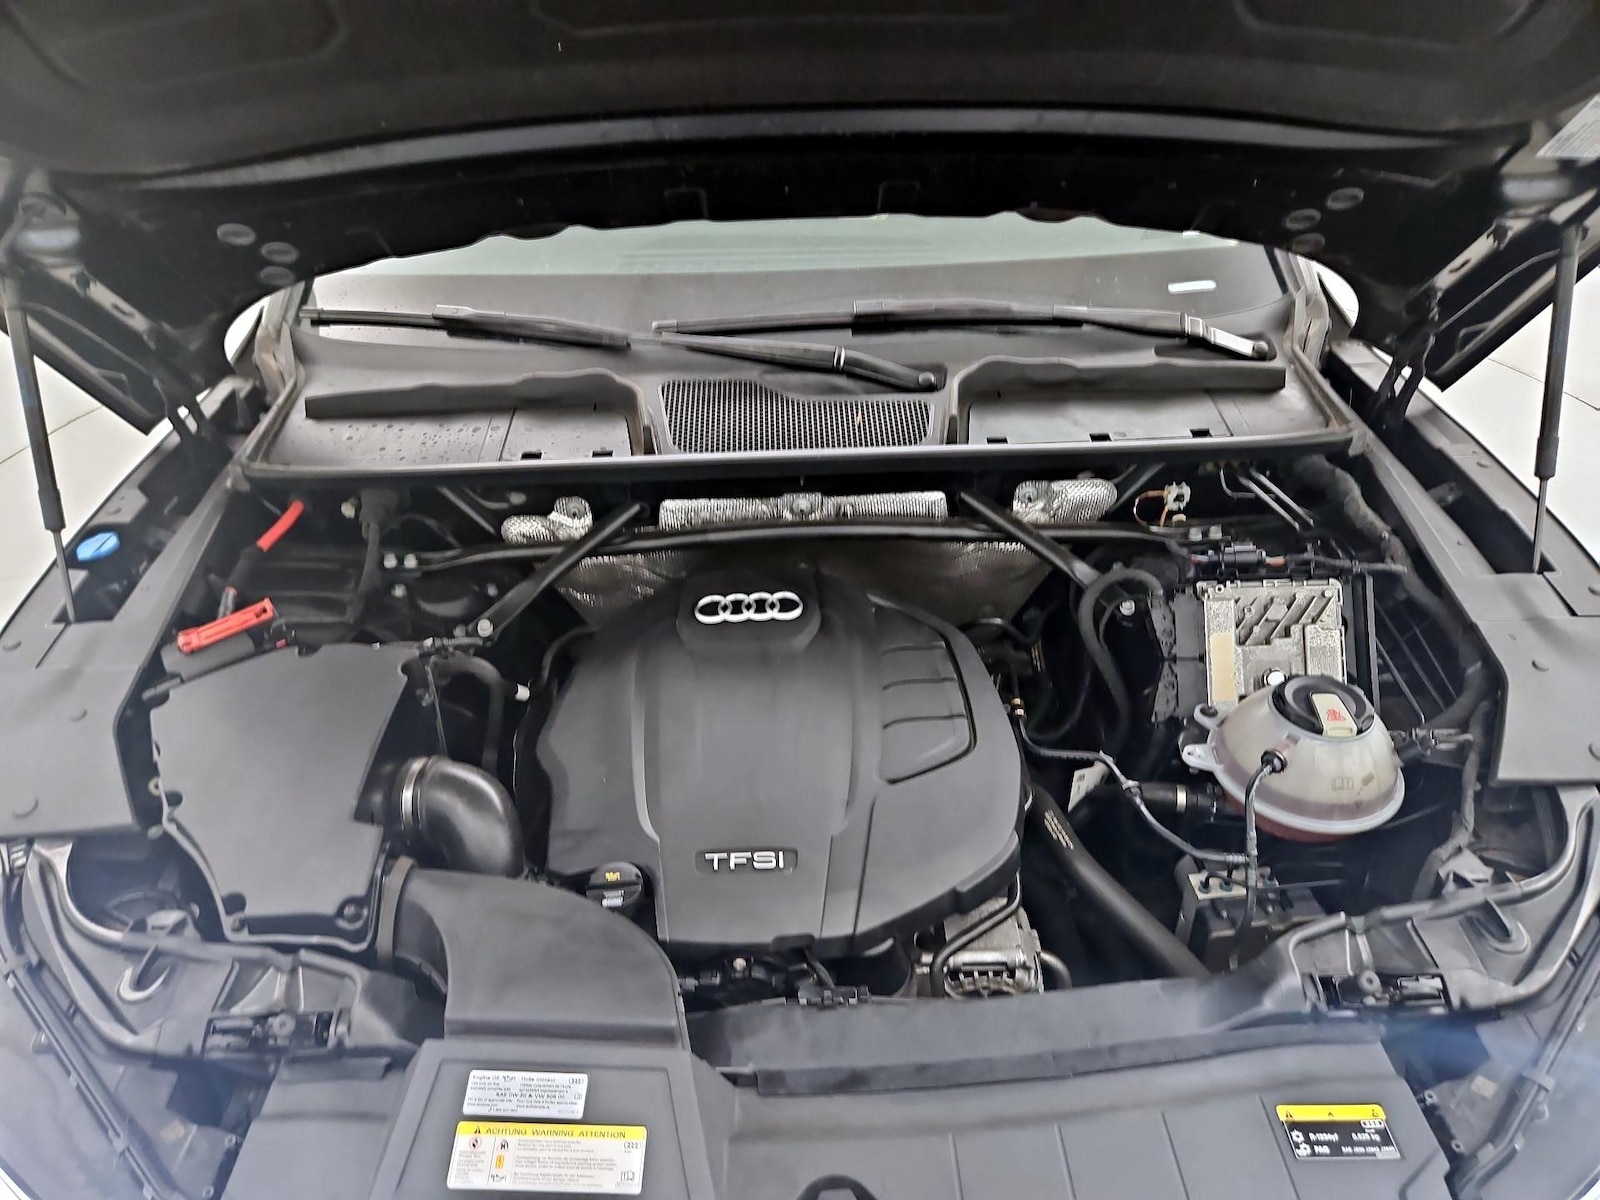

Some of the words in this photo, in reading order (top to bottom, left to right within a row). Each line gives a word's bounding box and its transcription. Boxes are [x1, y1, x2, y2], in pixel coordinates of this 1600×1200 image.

[704, 851, 785, 871] TFSI
[485, 1127, 527, 1136] ACHTUNG
[531, 1129, 574, 1137] WARNING
[578, 1130, 626, 1138] ATTENTION
